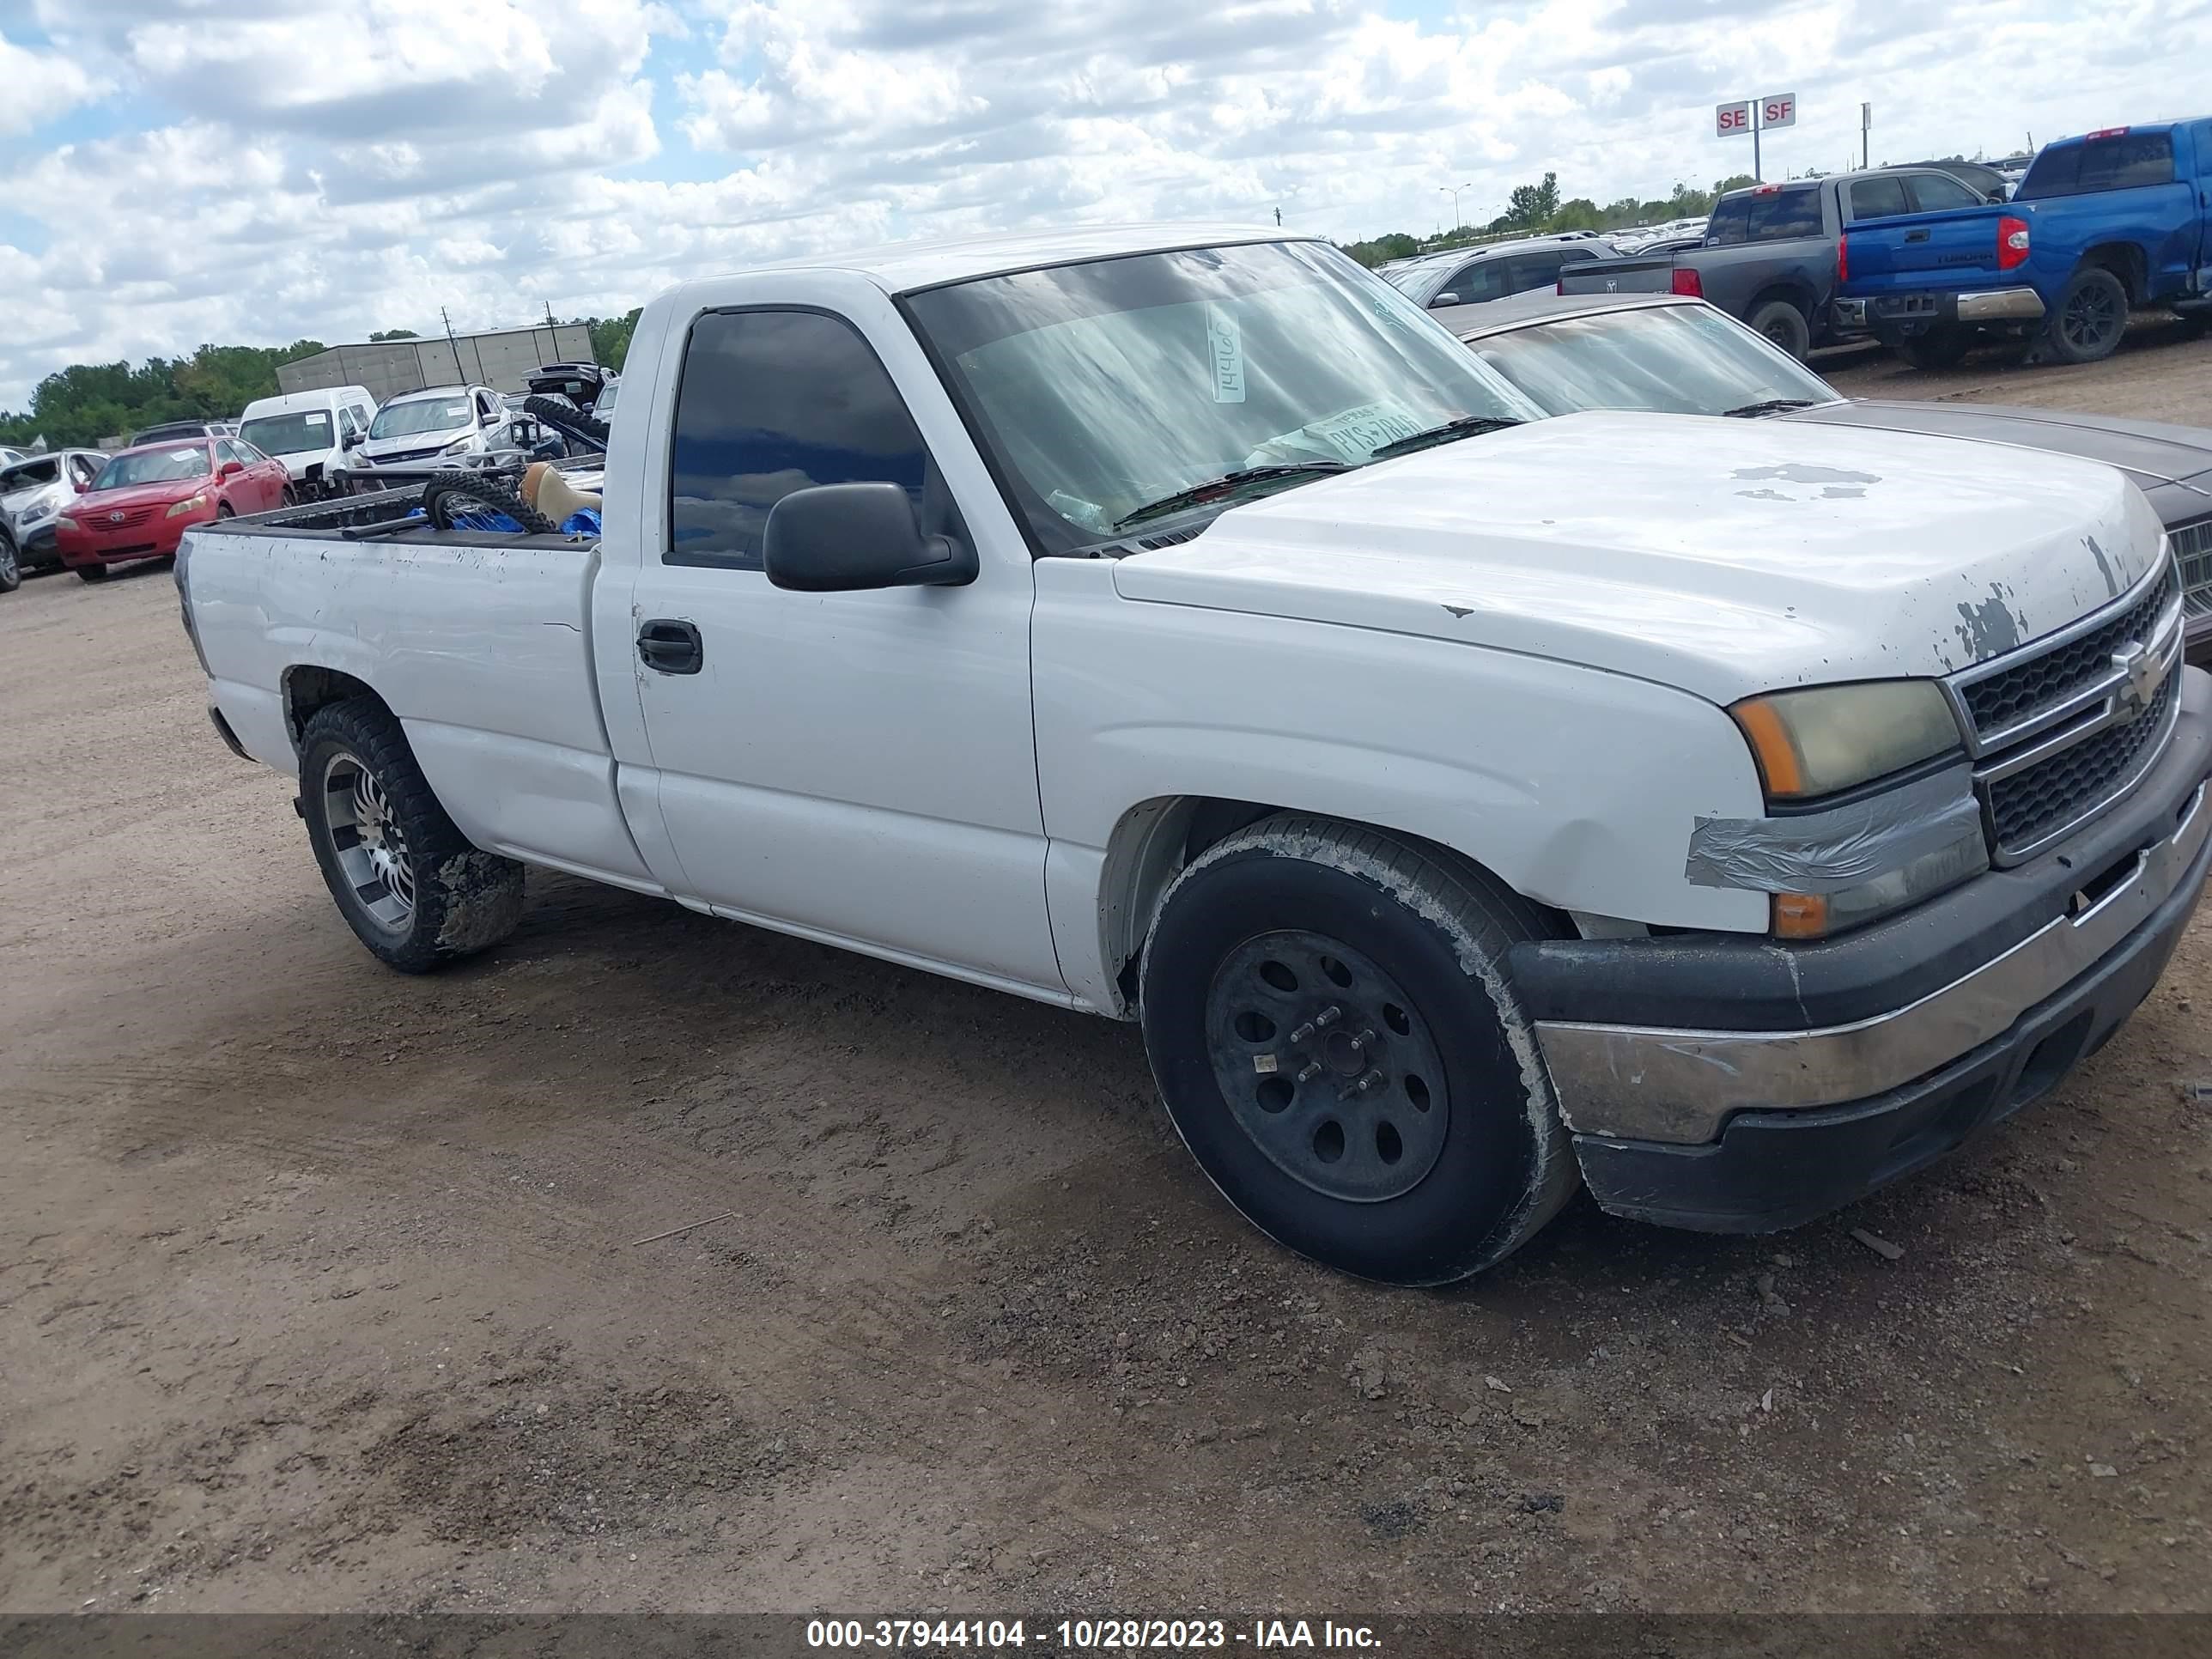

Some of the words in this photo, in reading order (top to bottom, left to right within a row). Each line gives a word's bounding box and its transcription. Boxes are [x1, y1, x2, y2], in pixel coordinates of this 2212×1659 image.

[1719, 109, 1746, 129] SE
[1765, 101, 1792, 121] SF
[1334, 408, 1375, 425] TEXAS
